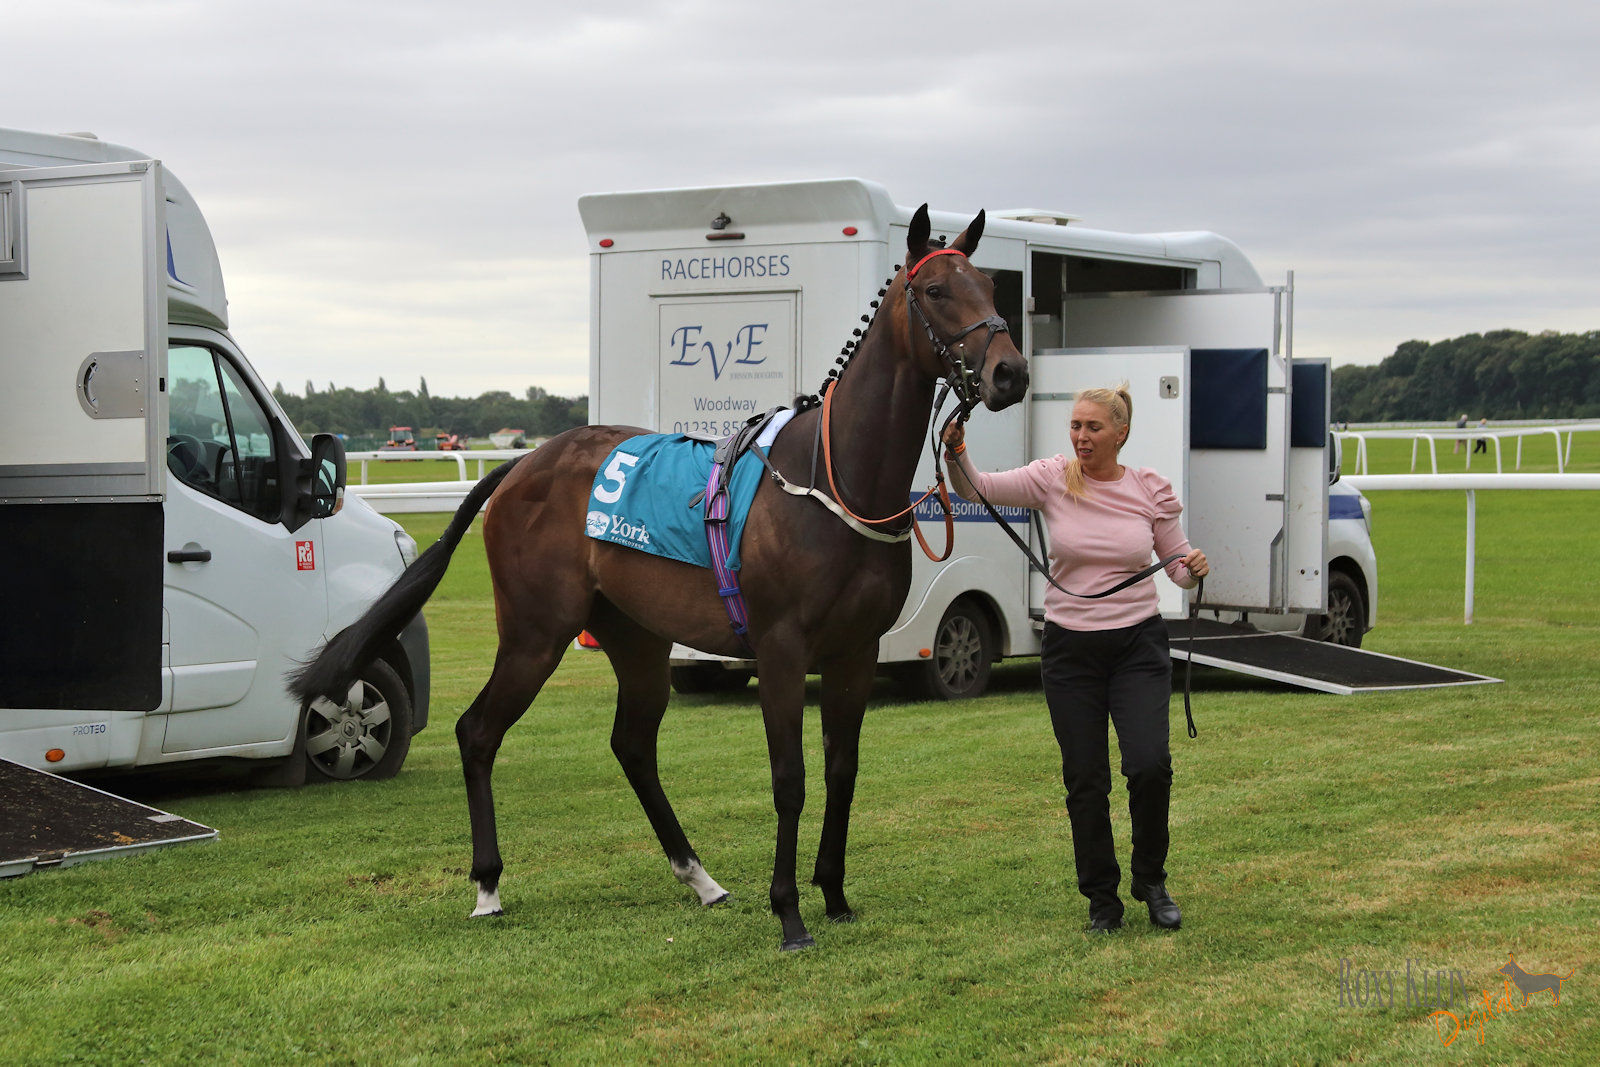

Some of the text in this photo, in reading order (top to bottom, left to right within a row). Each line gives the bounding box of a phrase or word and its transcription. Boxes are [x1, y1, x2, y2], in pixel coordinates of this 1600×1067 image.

[661, 254, 790, 280] RACEHORSES
[693, 396, 757, 413] Woodway
[673, 421, 718, 436] 01235
[593, 451, 640, 504] 5
[610, 514, 650, 545] York
[73, 724, 106, 735] PROTEO
